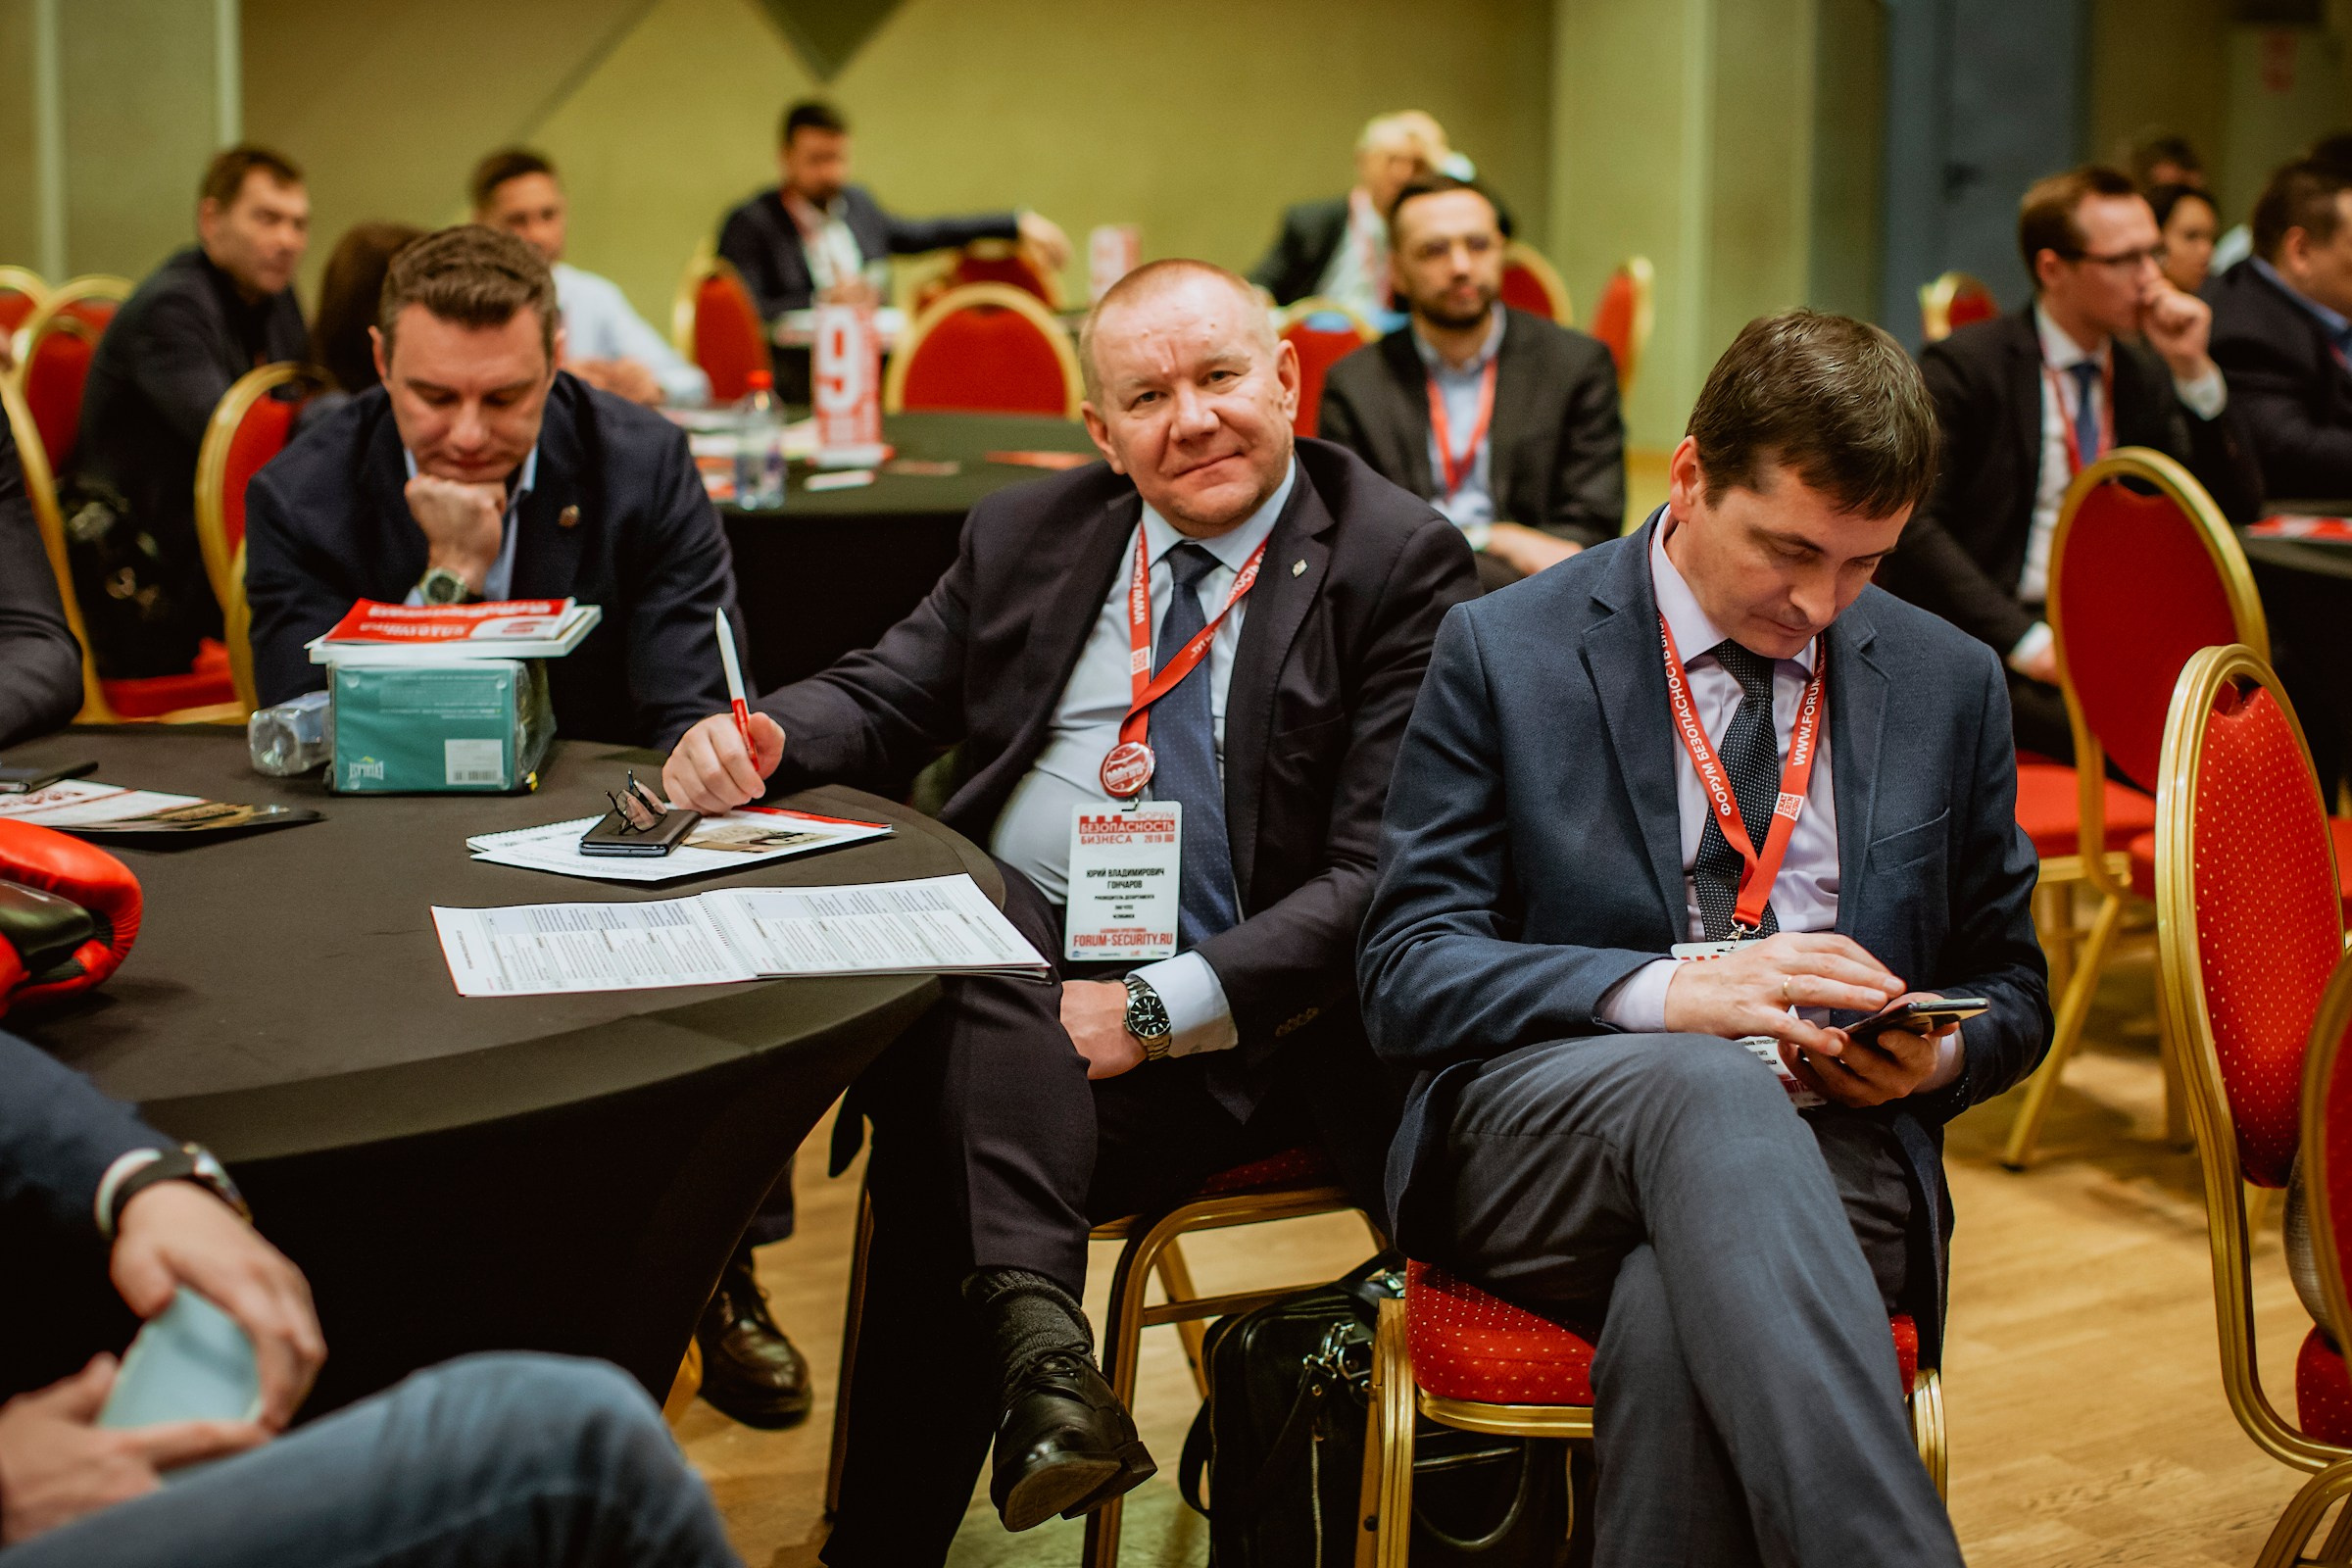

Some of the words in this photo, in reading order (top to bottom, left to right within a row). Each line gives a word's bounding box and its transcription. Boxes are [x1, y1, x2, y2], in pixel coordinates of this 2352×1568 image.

[817, 309, 860, 412] 9
[1663, 652, 1709, 761] БЕЗОПАСНОСТЬ
[1701, 762, 1732, 816] ФОРУМ
[1135, 811, 1175, 820] ФОРУМ
[1080, 821, 1174, 834] БЕЗОПАСНОСТЬ
[1081, 834, 1132, 845] БИЗНЕСА
[1087, 867, 1106, 877] ЮРИЙ
[1108, 867, 1164, 878] ВЛАДИМИРОВИЧ
[1107, 880, 1143, 889] ГОНЧАРОВ
[1073, 933, 1173, 947] FORUM-SECURITY.RU
